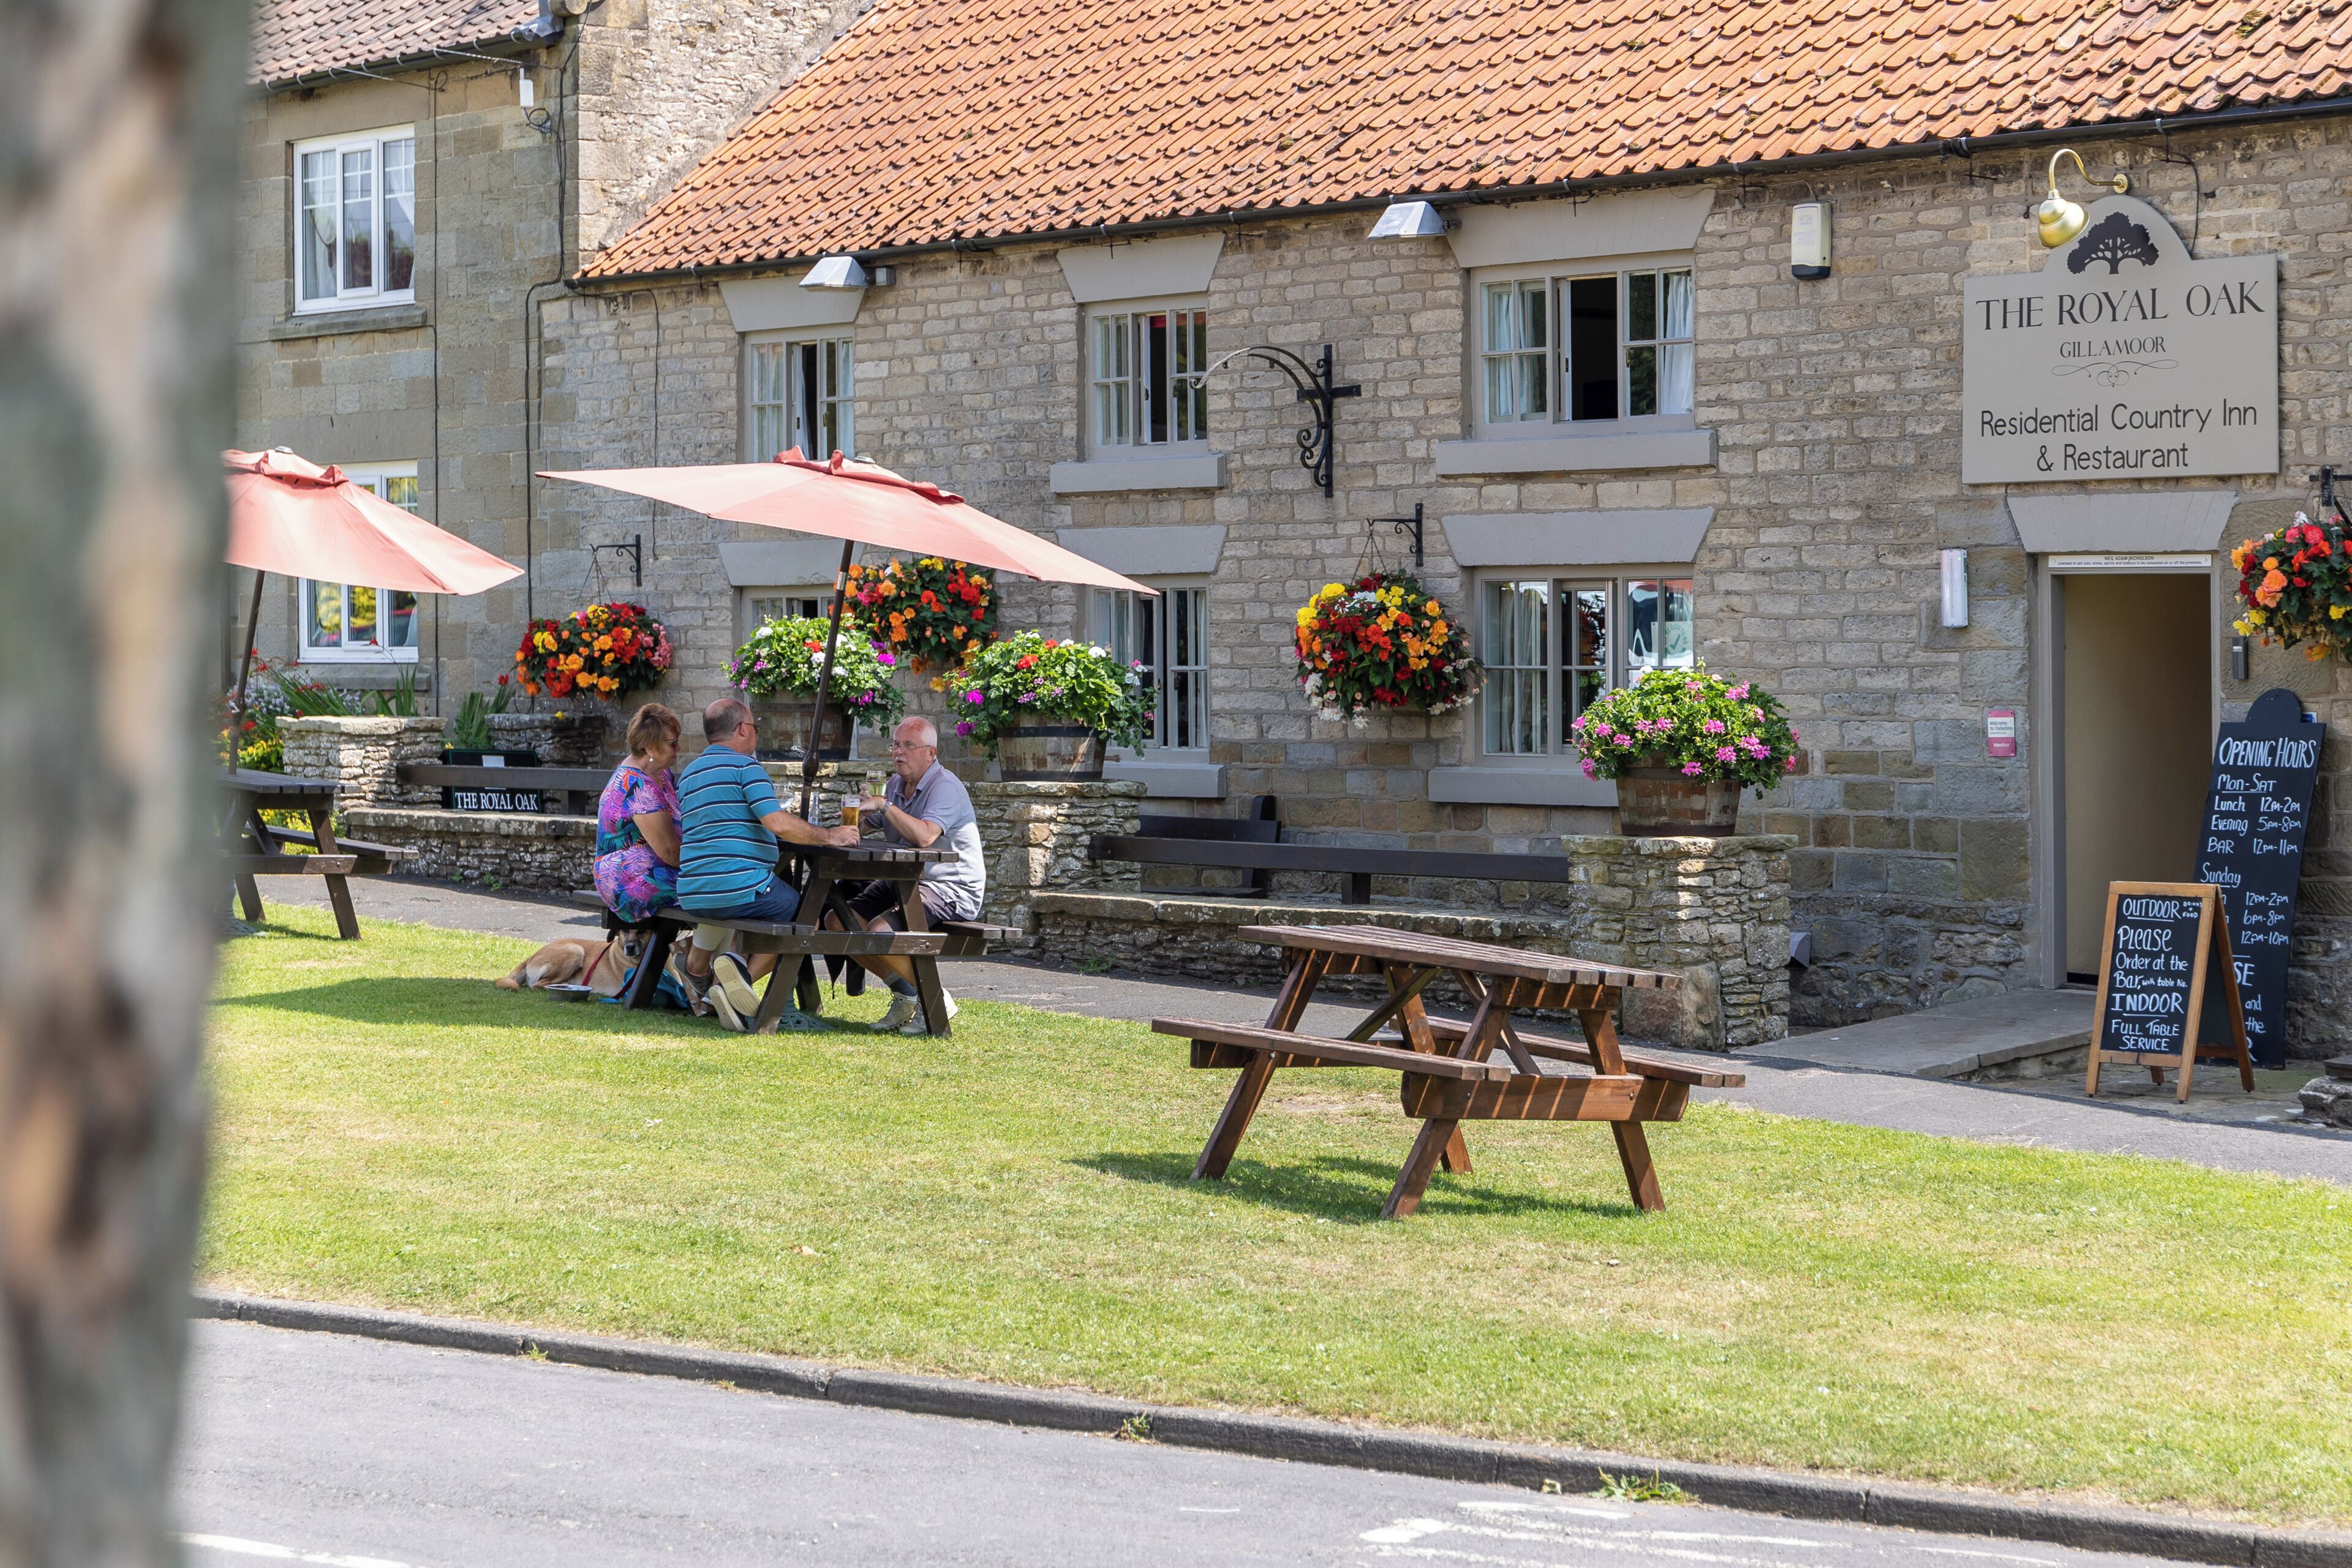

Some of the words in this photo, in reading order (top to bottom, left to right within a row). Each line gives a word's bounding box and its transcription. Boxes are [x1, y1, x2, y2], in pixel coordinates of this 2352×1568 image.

[1976, 296, 2043, 330] THE
[2058, 288, 2169, 325] ROYAL
[2186, 281, 2266, 317] OAK
[2060, 336, 2166, 358] GILLAMOOR
[1981, 404, 2098, 437] Residential
[2111, 403, 2212, 433] Country
[2223, 398, 2257, 426] Inn
[2037, 445, 2054, 472] &
[2064, 442, 2188, 471] Restaurant
[2218, 737, 2275, 767] OPENING
[2274, 737, 2316, 768] HOURS
[455, 792, 478, 809] THE
[479, 793, 514, 810] ROYAL
[515, 793, 538, 810] OAK
[2214, 795, 2246, 812] Lunch
[2207, 837, 2235, 854] BAR
[2200, 862, 2241, 888] Sunday
[2123, 898, 2182, 919] OUTDOOR
[2116, 952, 2151, 970] Order
[2152, 954, 2165, 970] at
[2169, 955, 2188, 971] the
[2157, 976, 2175, 987] table
[2111, 992, 2184, 1014] INDOOR
[2245, 993, 2262, 1011] and
[2111, 1019, 2143, 1035] FULL
[2145, 1019, 2180, 1036] TABLE
[2245, 1016, 2266, 1033] the
[2119, 1035, 2169, 1051] SERVICE
